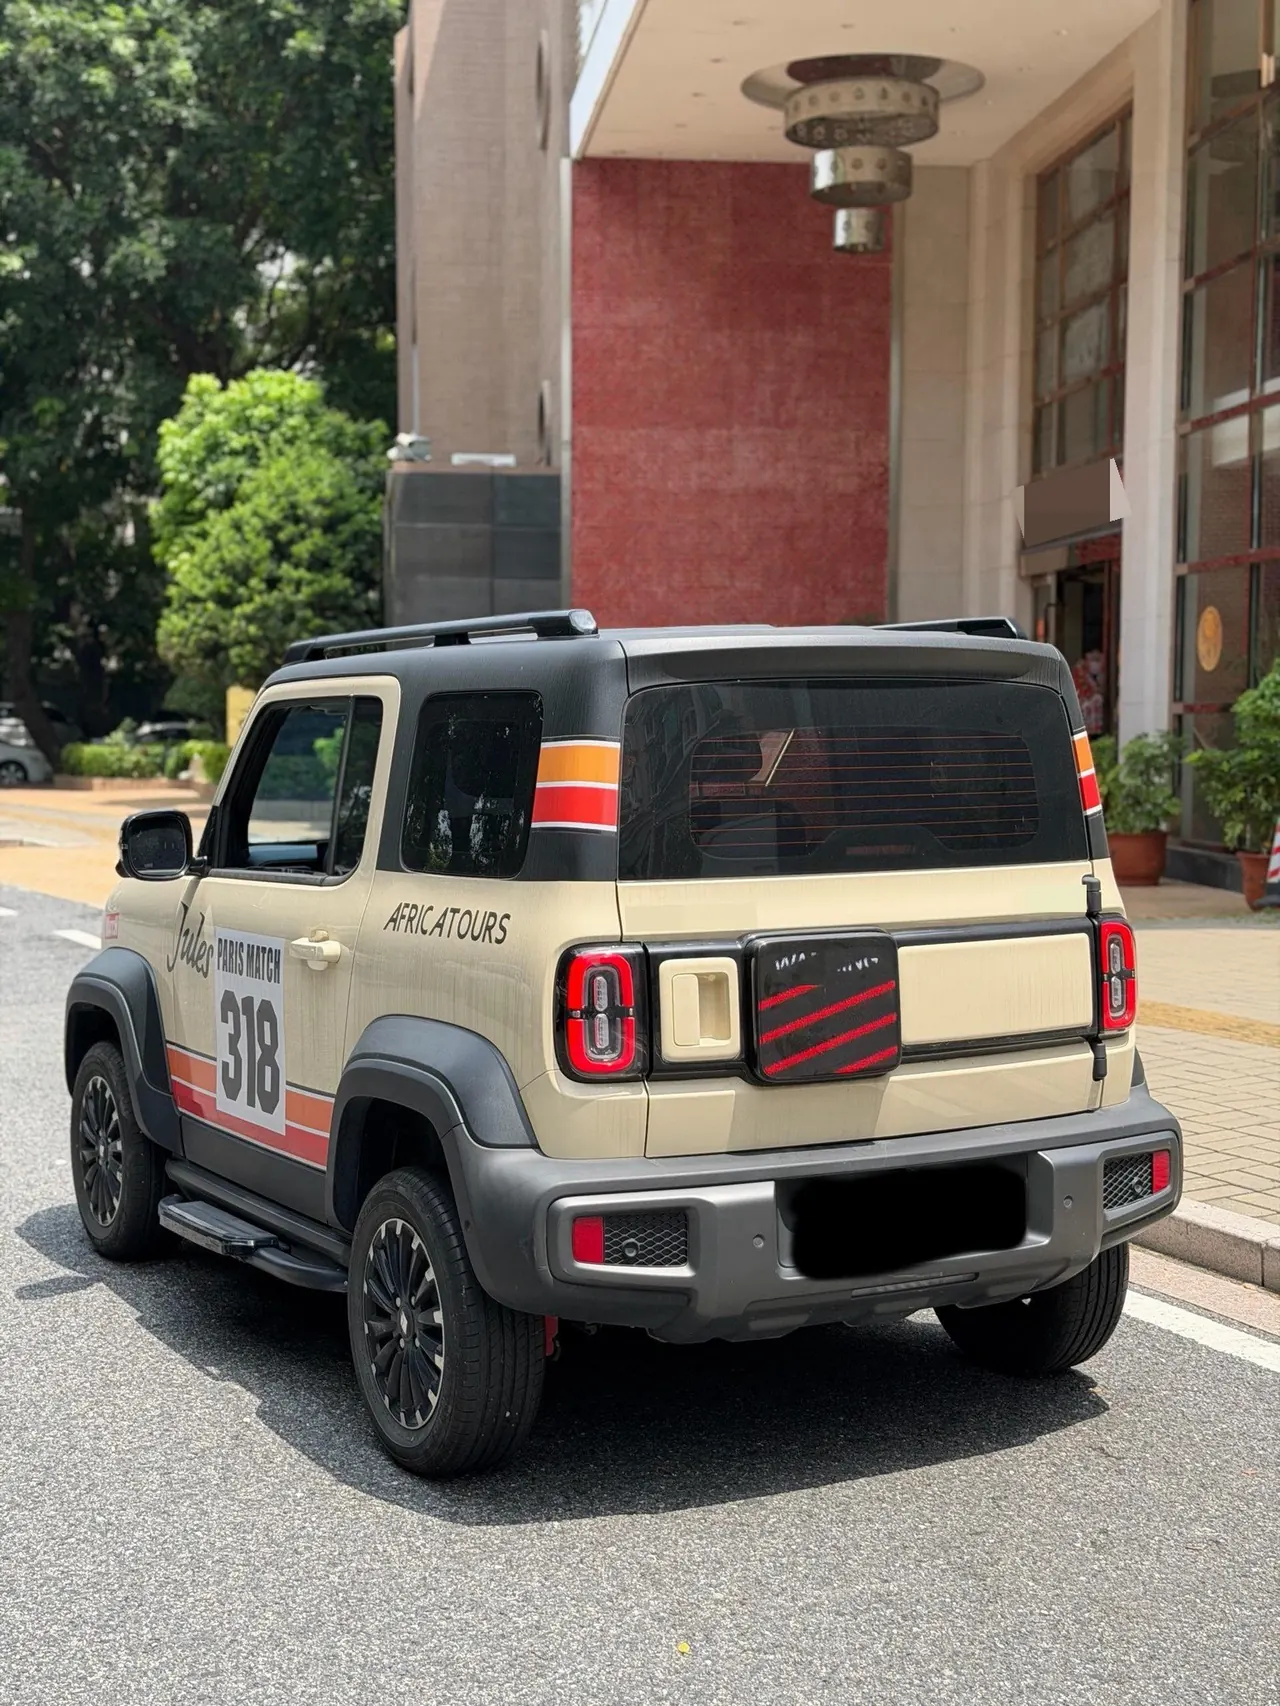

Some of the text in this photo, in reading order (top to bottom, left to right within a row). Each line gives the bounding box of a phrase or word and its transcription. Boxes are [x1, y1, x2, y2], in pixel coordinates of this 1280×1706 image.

[167, 901, 214, 978] Jules
[383, 902, 511, 944] AFRICATOURS
[217, 938, 281, 984] PARIS MATCH
[220, 989, 280, 1115] 318
